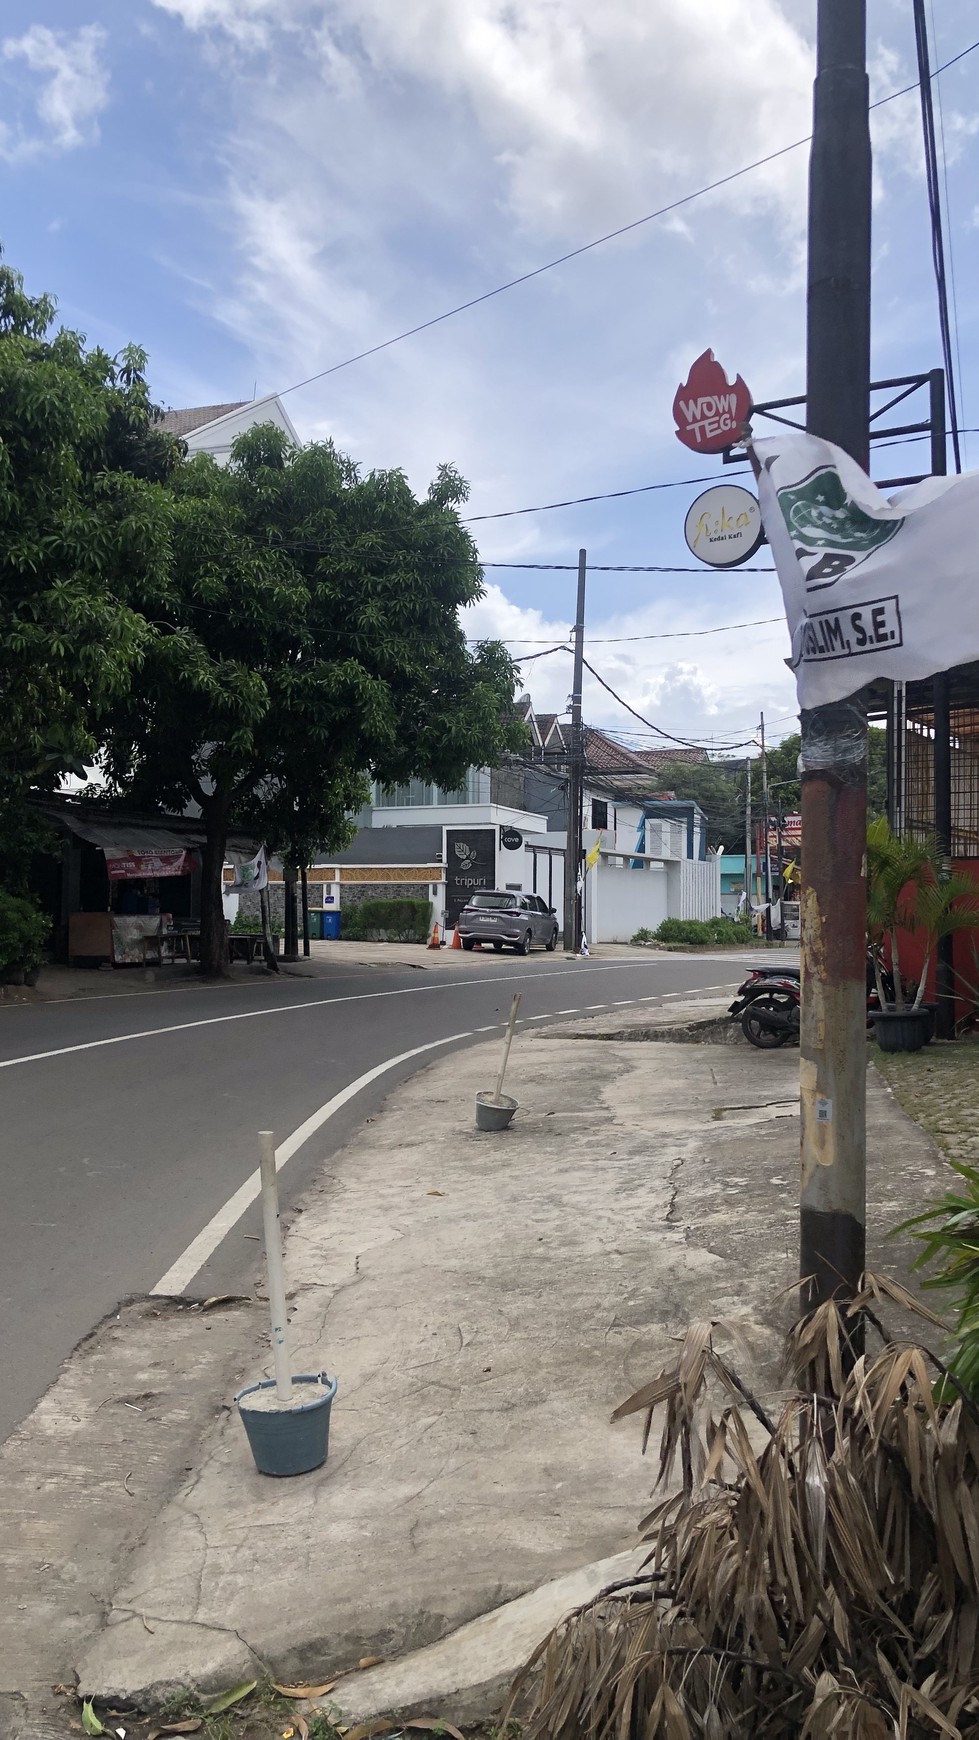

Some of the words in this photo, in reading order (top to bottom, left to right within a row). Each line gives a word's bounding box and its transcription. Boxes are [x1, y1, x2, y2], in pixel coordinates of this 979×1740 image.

[709, 534, 727, 543] Kedai
[851, 606, 895, 646] S.E.
[454, 875, 486, 888] tripuri
